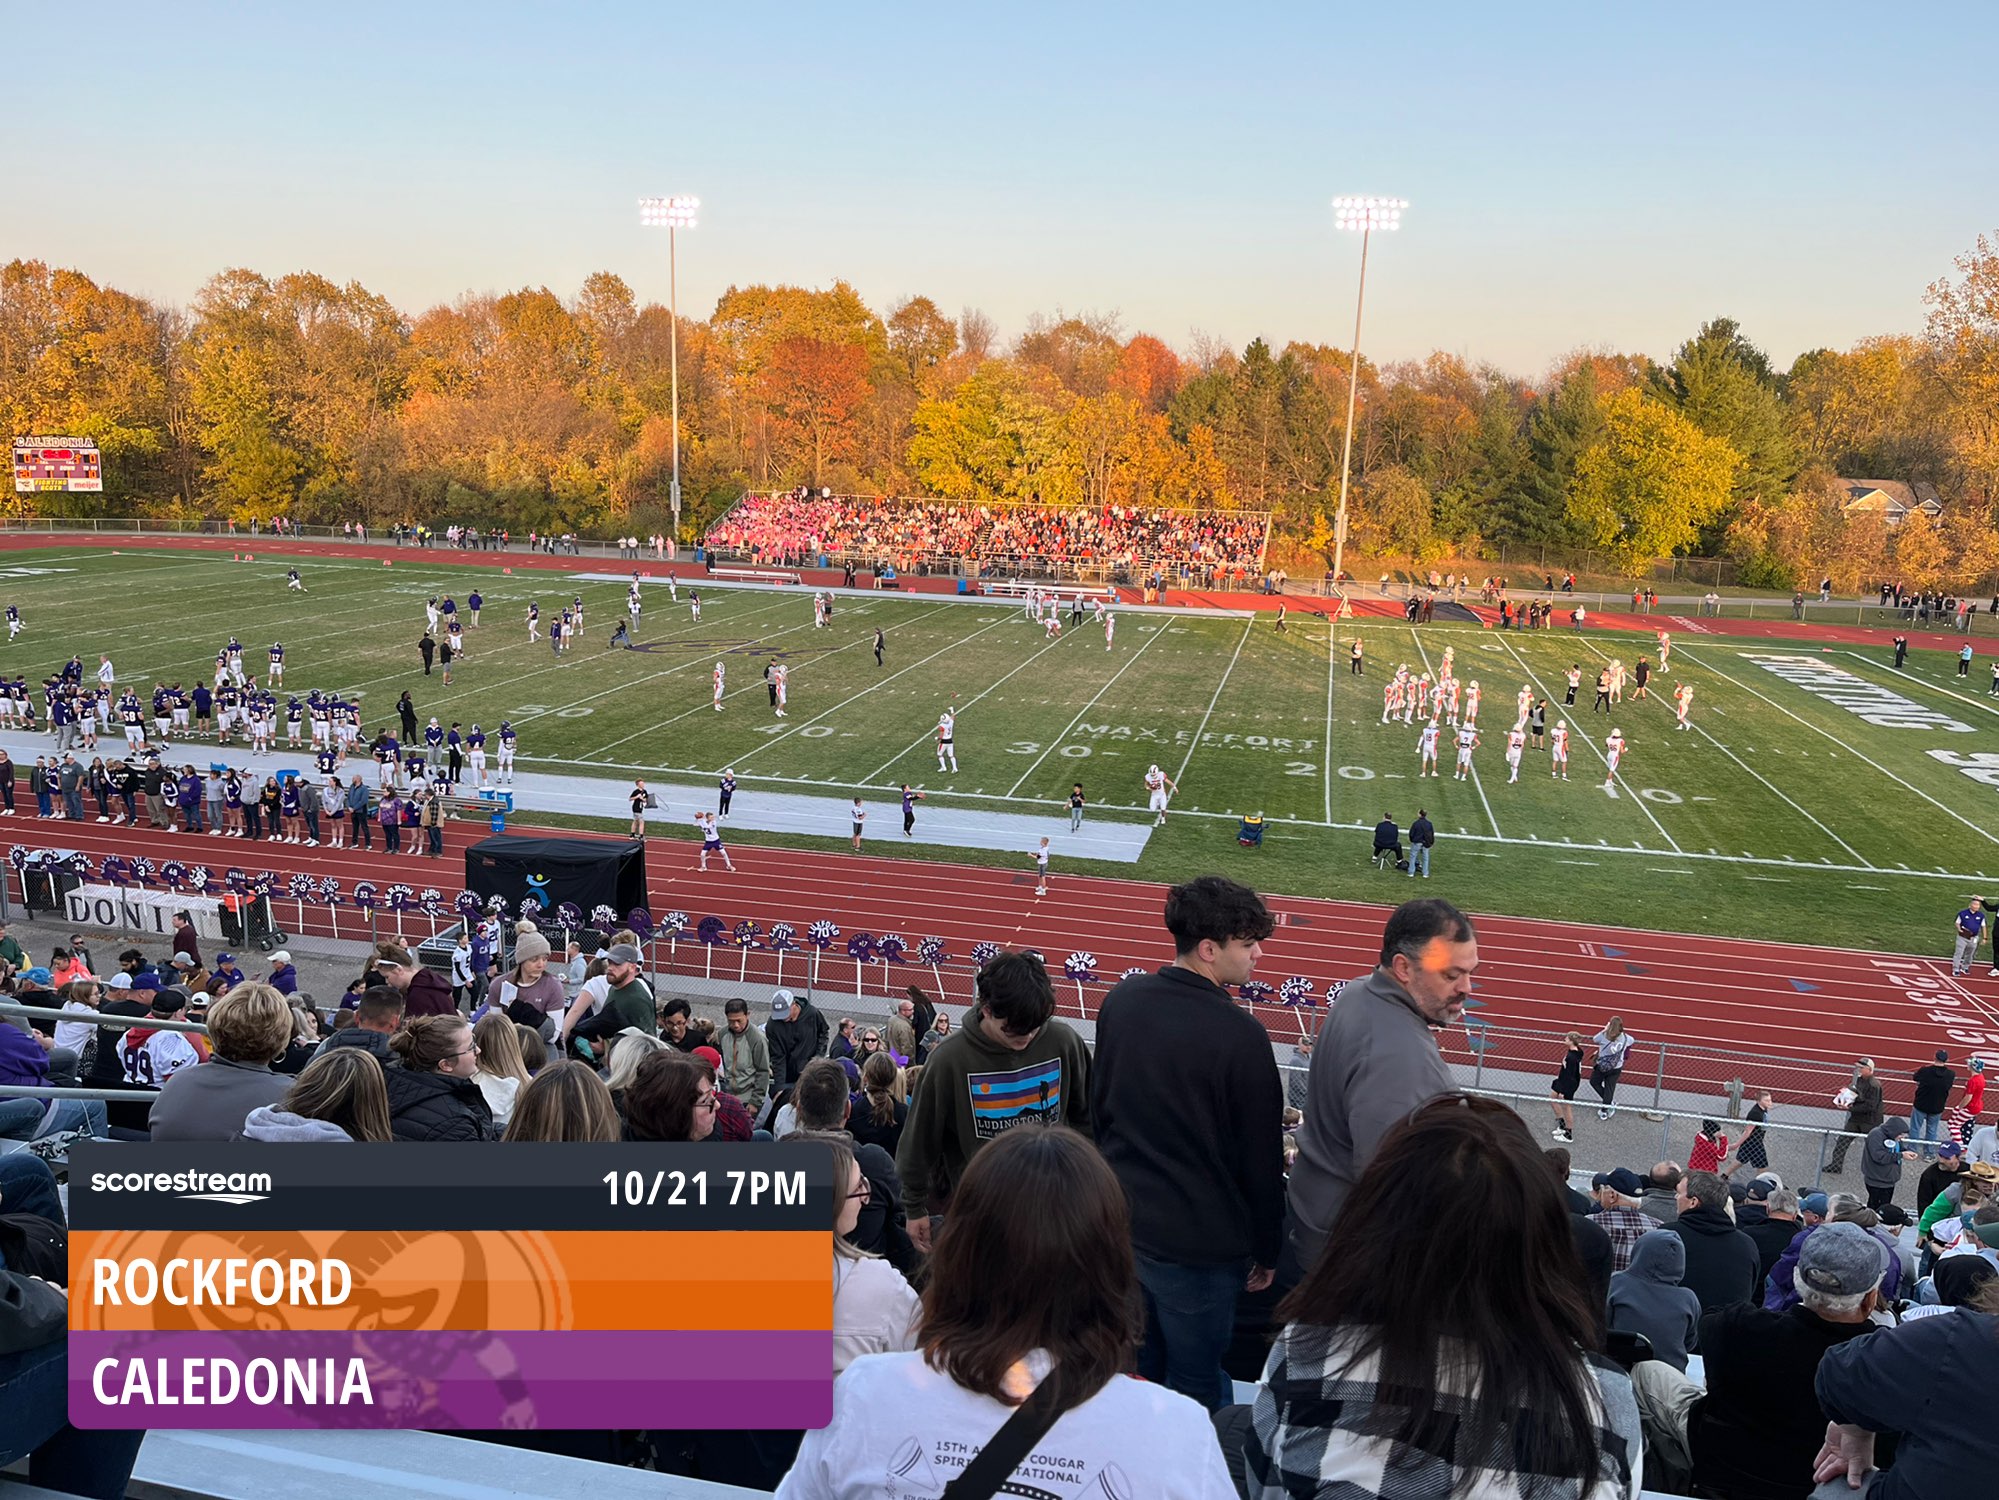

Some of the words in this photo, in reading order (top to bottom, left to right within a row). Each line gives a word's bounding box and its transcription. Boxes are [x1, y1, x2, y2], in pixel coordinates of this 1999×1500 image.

[16, 437, 94, 448] CALEDONIA
[74, 482, 99, 490] meijer
[271, 653, 281, 662] 17
[123, 710, 136, 722] 58
[1076, 723, 1158, 738] MAX
[1174, 730, 1319, 749] EFFORT
[322, 757, 330, 770] 3
[434, 783, 447, 796] 33
[137, 865, 146, 877] 3
[255, 882, 270, 895] 28
[288, 873, 318, 898] MATHIEU
[299, 882, 308, 893] 8
[319, 877, 340, 894] RUSSO
[384, 884, 415, 907] HERRON
[395, 893, 403, 904] 7
[735, 925, 761, 935] SCAVO
[807, 920, 840, 937] LUXFORD
[816, 927, 830, 939] 70
[1064, 951, 1098, 968] BEYER
[1073, 962, 1087, 972] 24
[1279, 976, 1314, 1005] VOGELER
[123, 1046, 155, 1084] 99
[977, 1113, 1044, 1130] LUDINGTON
[935, 1440, 968, 1454] 15TH
[1029, 1454, 1086, 1471] COUGAR
[1015, 1465, 1083, 1485] TATIONAL
